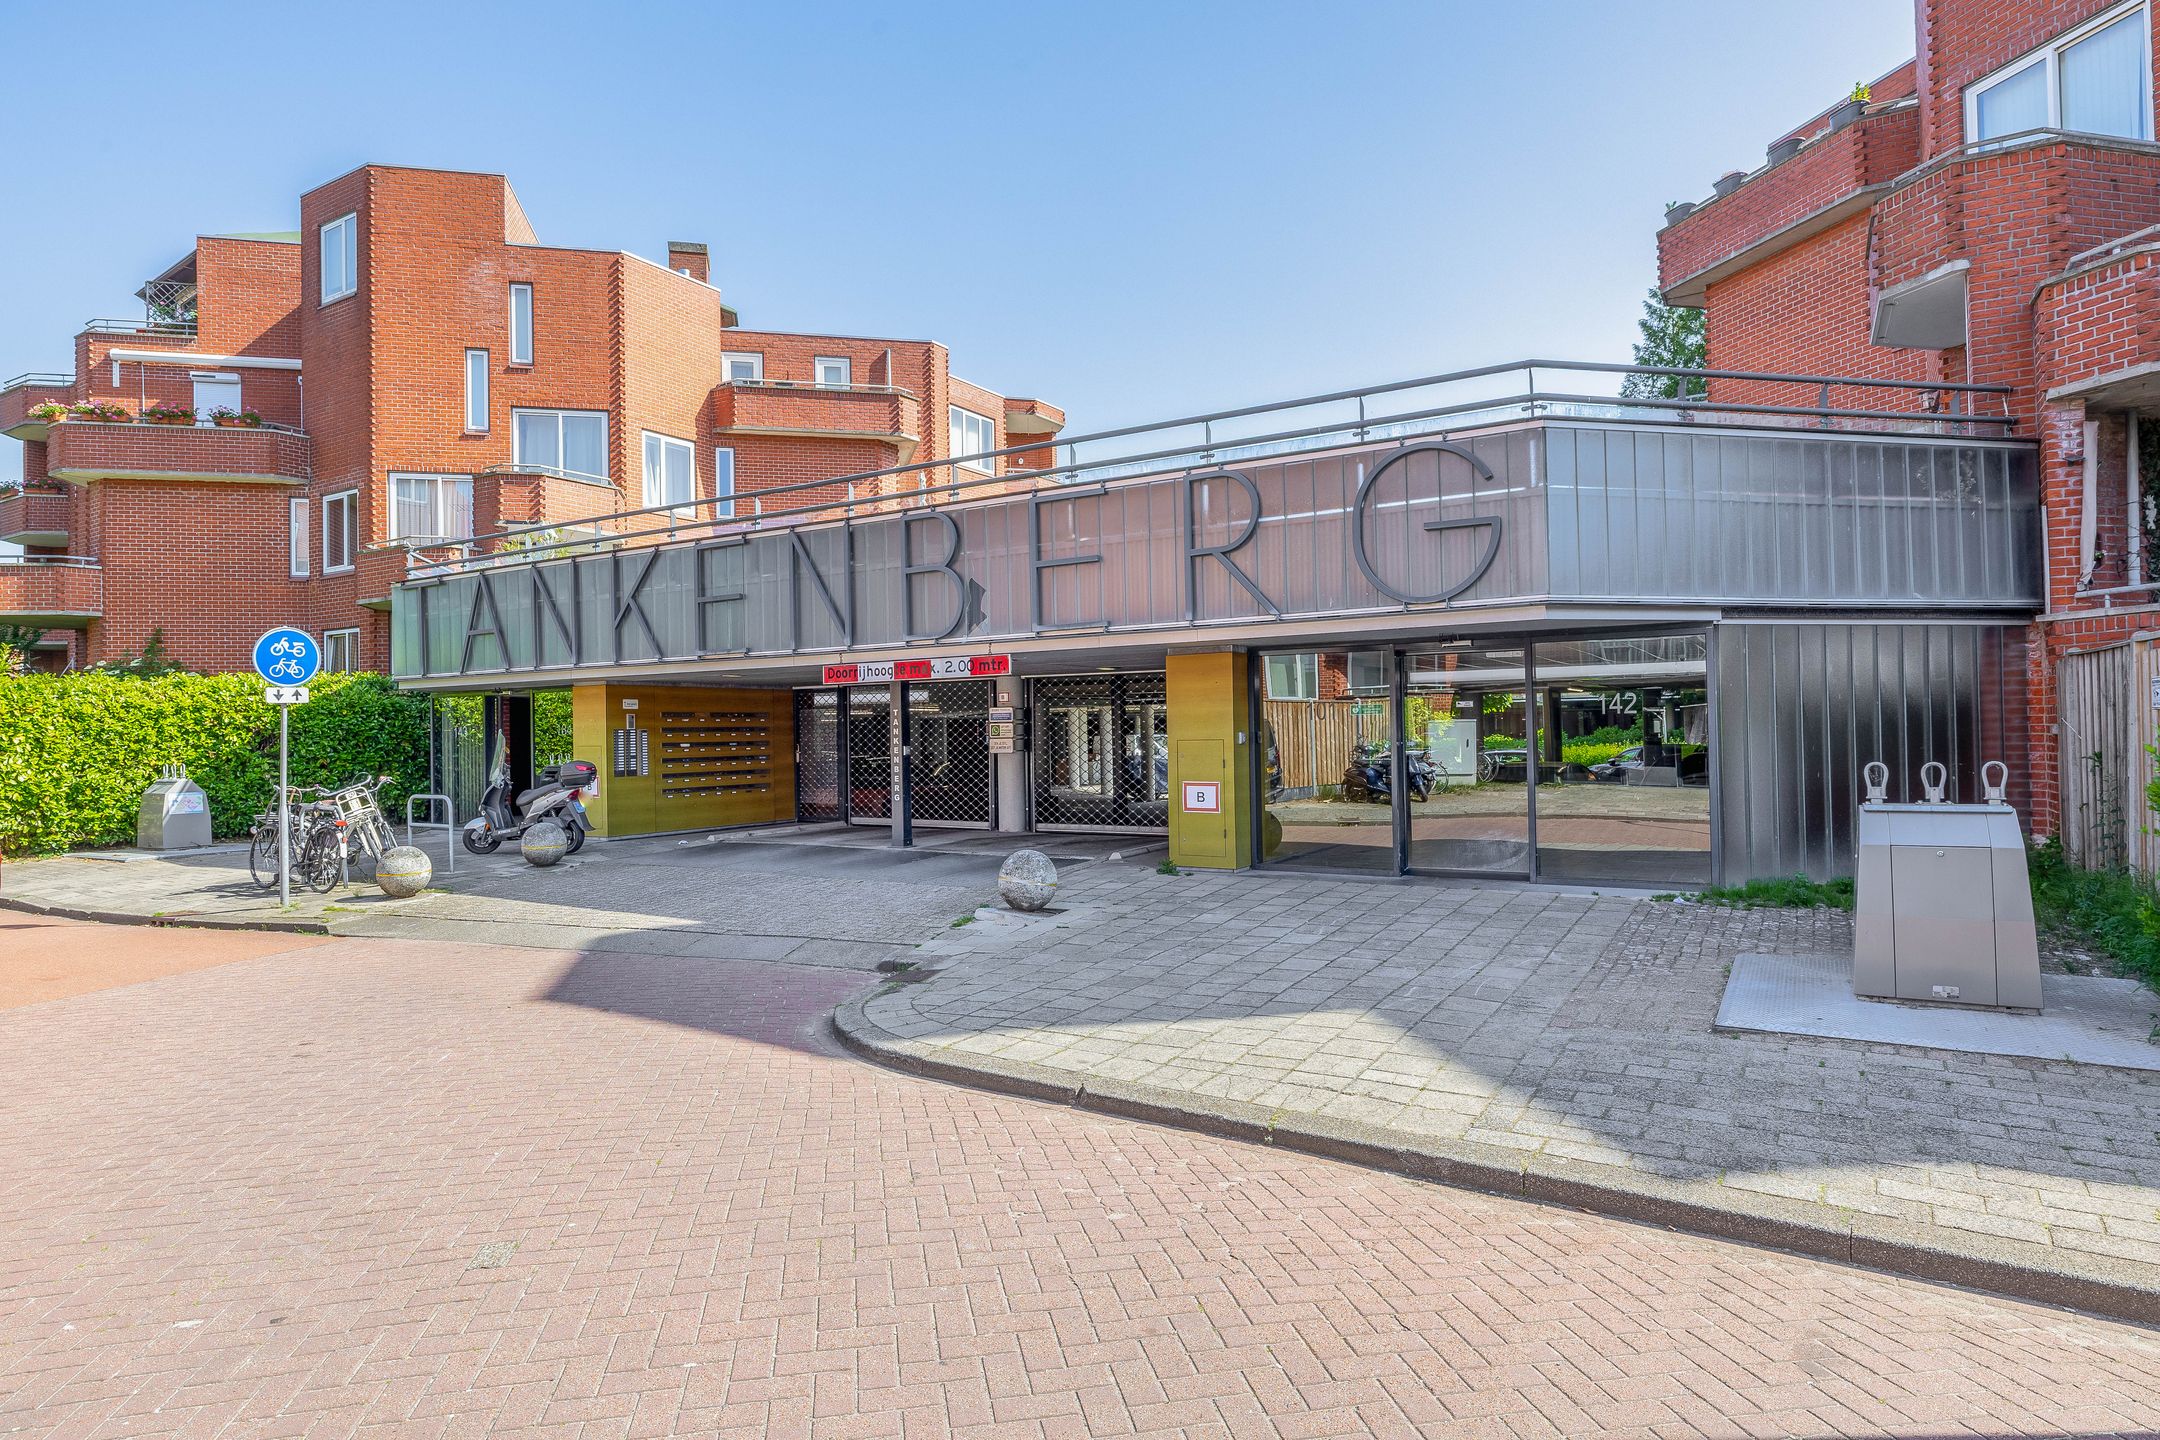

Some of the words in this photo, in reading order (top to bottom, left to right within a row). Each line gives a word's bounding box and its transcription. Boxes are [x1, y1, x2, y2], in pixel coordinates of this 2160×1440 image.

[400, 441, 1503, 677] TANKENBERG
[828, 664, 905, 681] Doorrijhoogte
[909, 663, 940, 675] max.
[944, 660, 974, 673] 2.00
[979, 658, 1006, 672] mtr.
[1306, 702, 1336, 720] 101
[1598, 692, 1637, 715] 142
[1196, 791, 1206, 803] B
